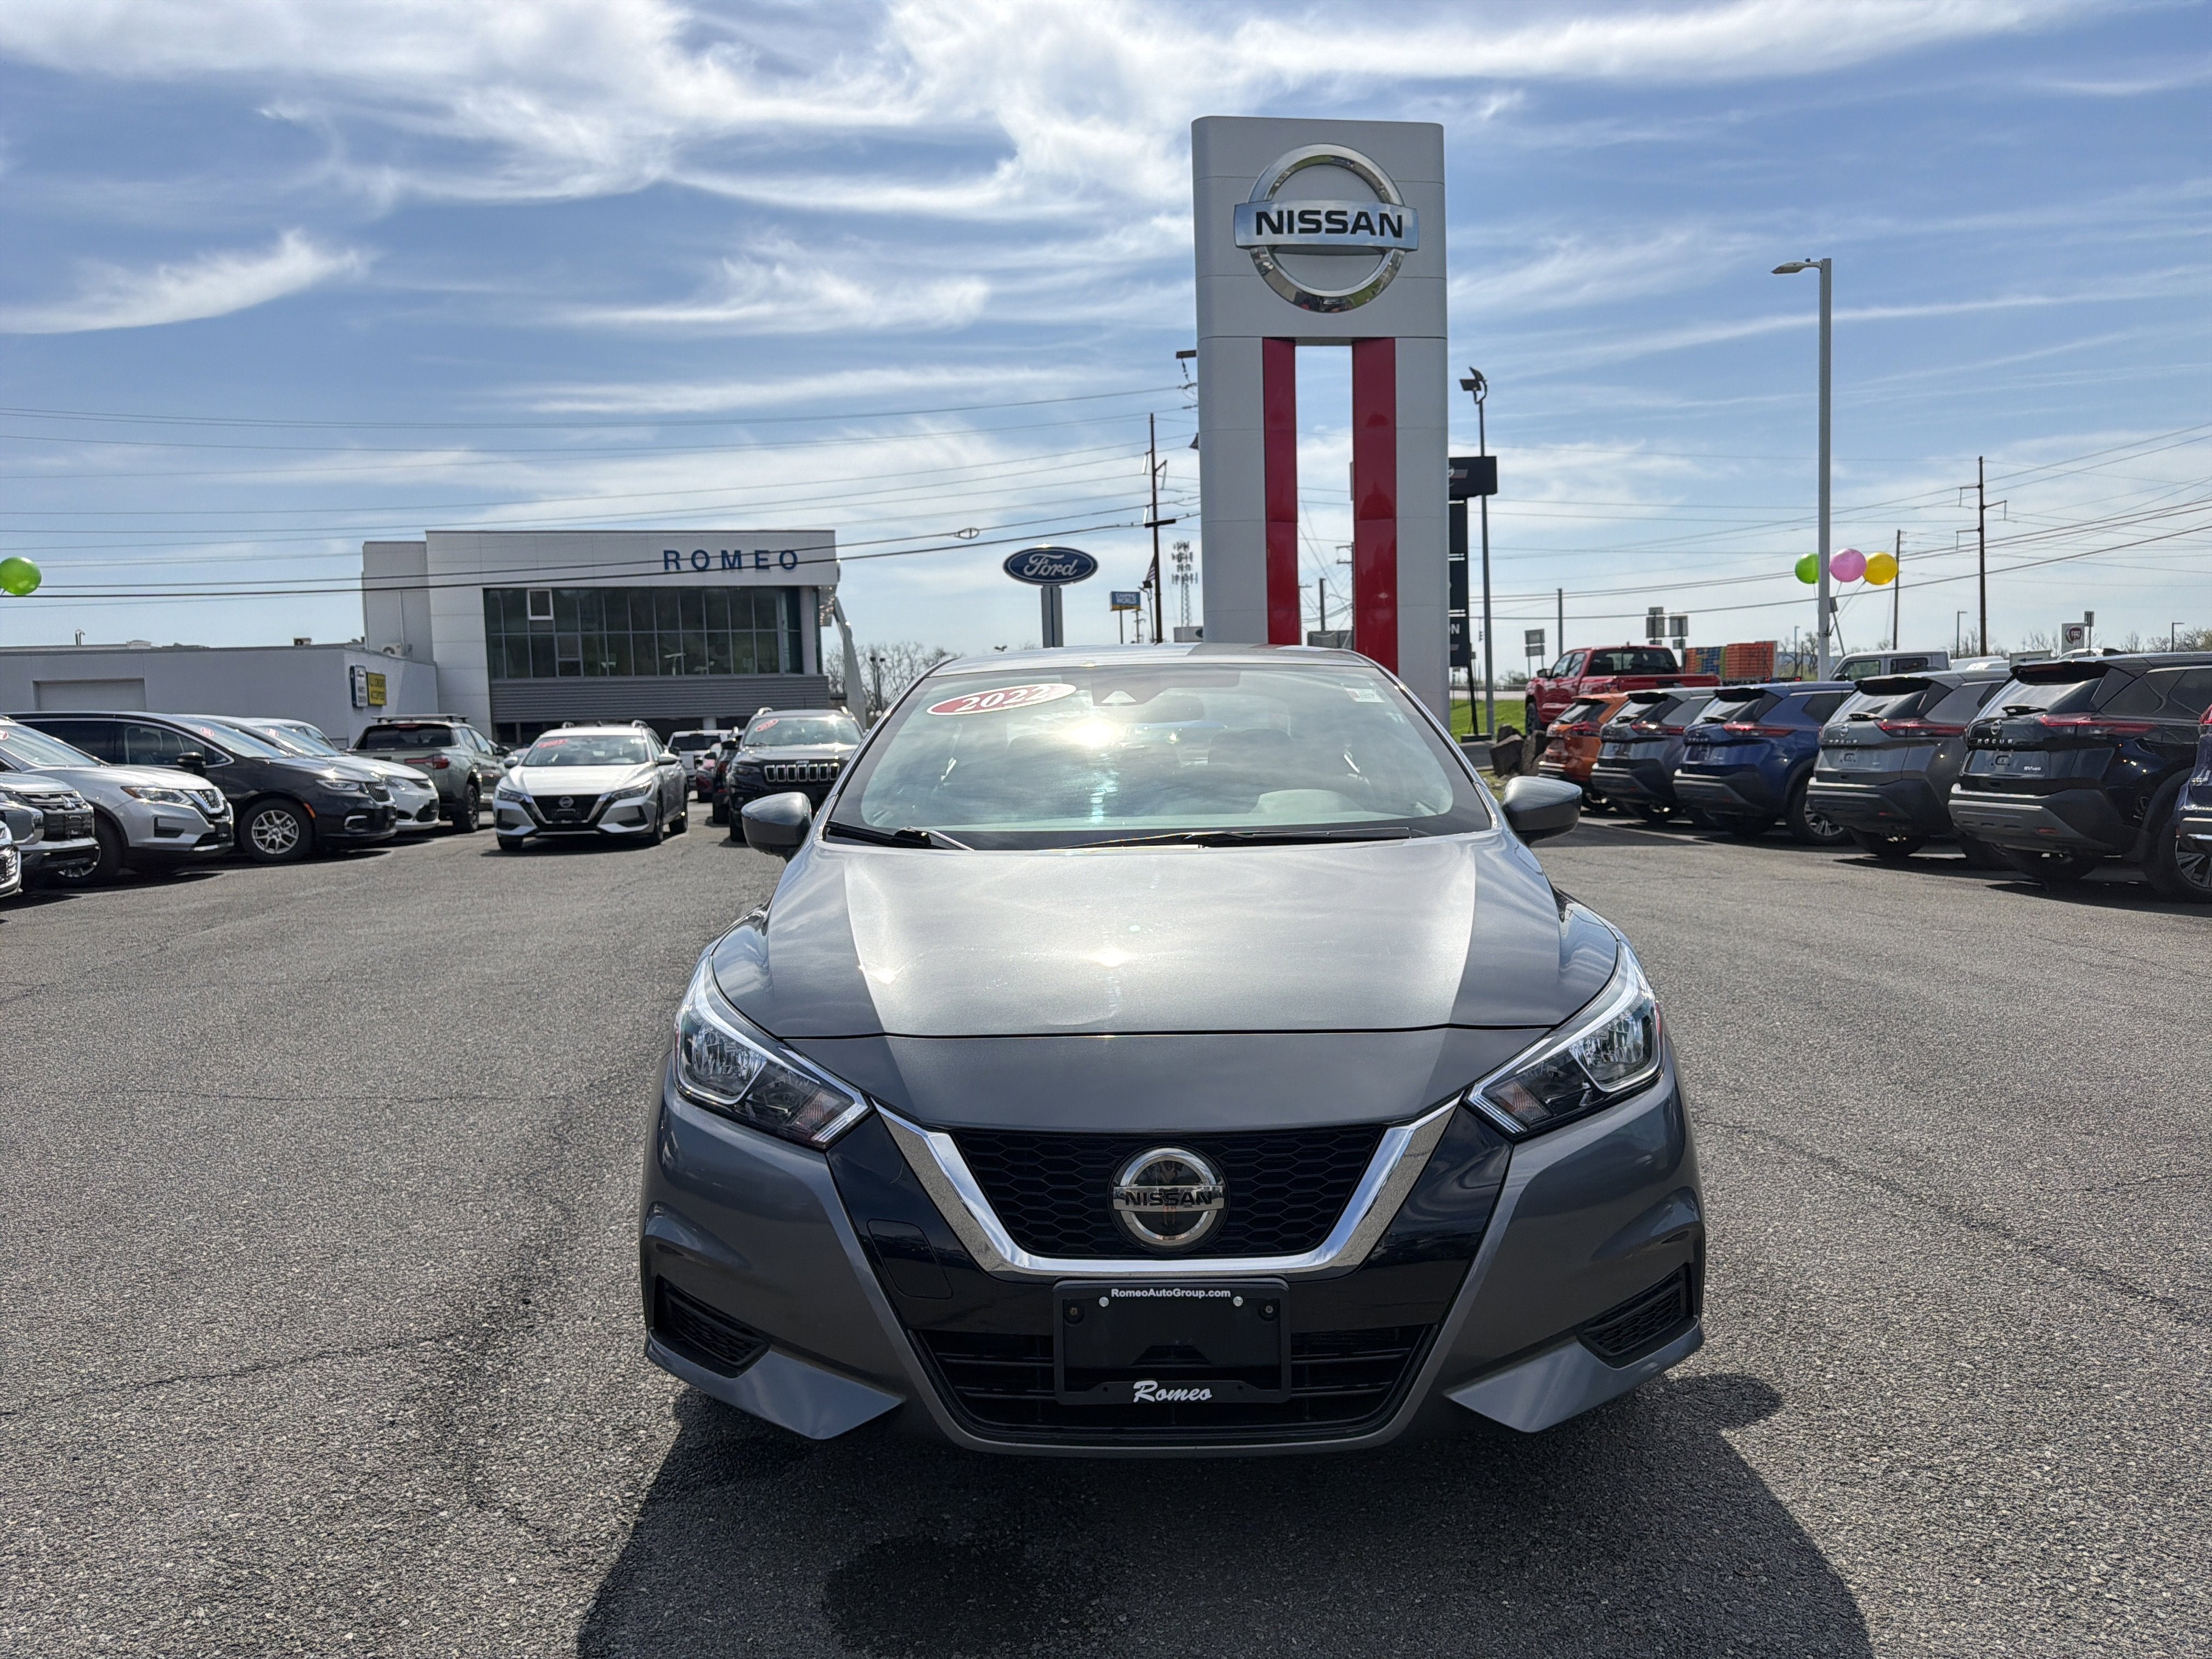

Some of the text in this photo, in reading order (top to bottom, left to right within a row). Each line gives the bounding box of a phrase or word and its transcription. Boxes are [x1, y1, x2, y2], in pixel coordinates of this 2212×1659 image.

[1256, 210, 1403, 238] NISSAN
[663, 549, 798, 571] ROMEO
[1023, 553, 1078, 576] Ford
[953, 686, 1051, 712] 2022
[1125, 1189, 1212, 1207] NISSAN
[1111, 1288, 1231, 1299] RomeoAutoGroup.com
[1133, 1380, 1212, 1403] Romeo
